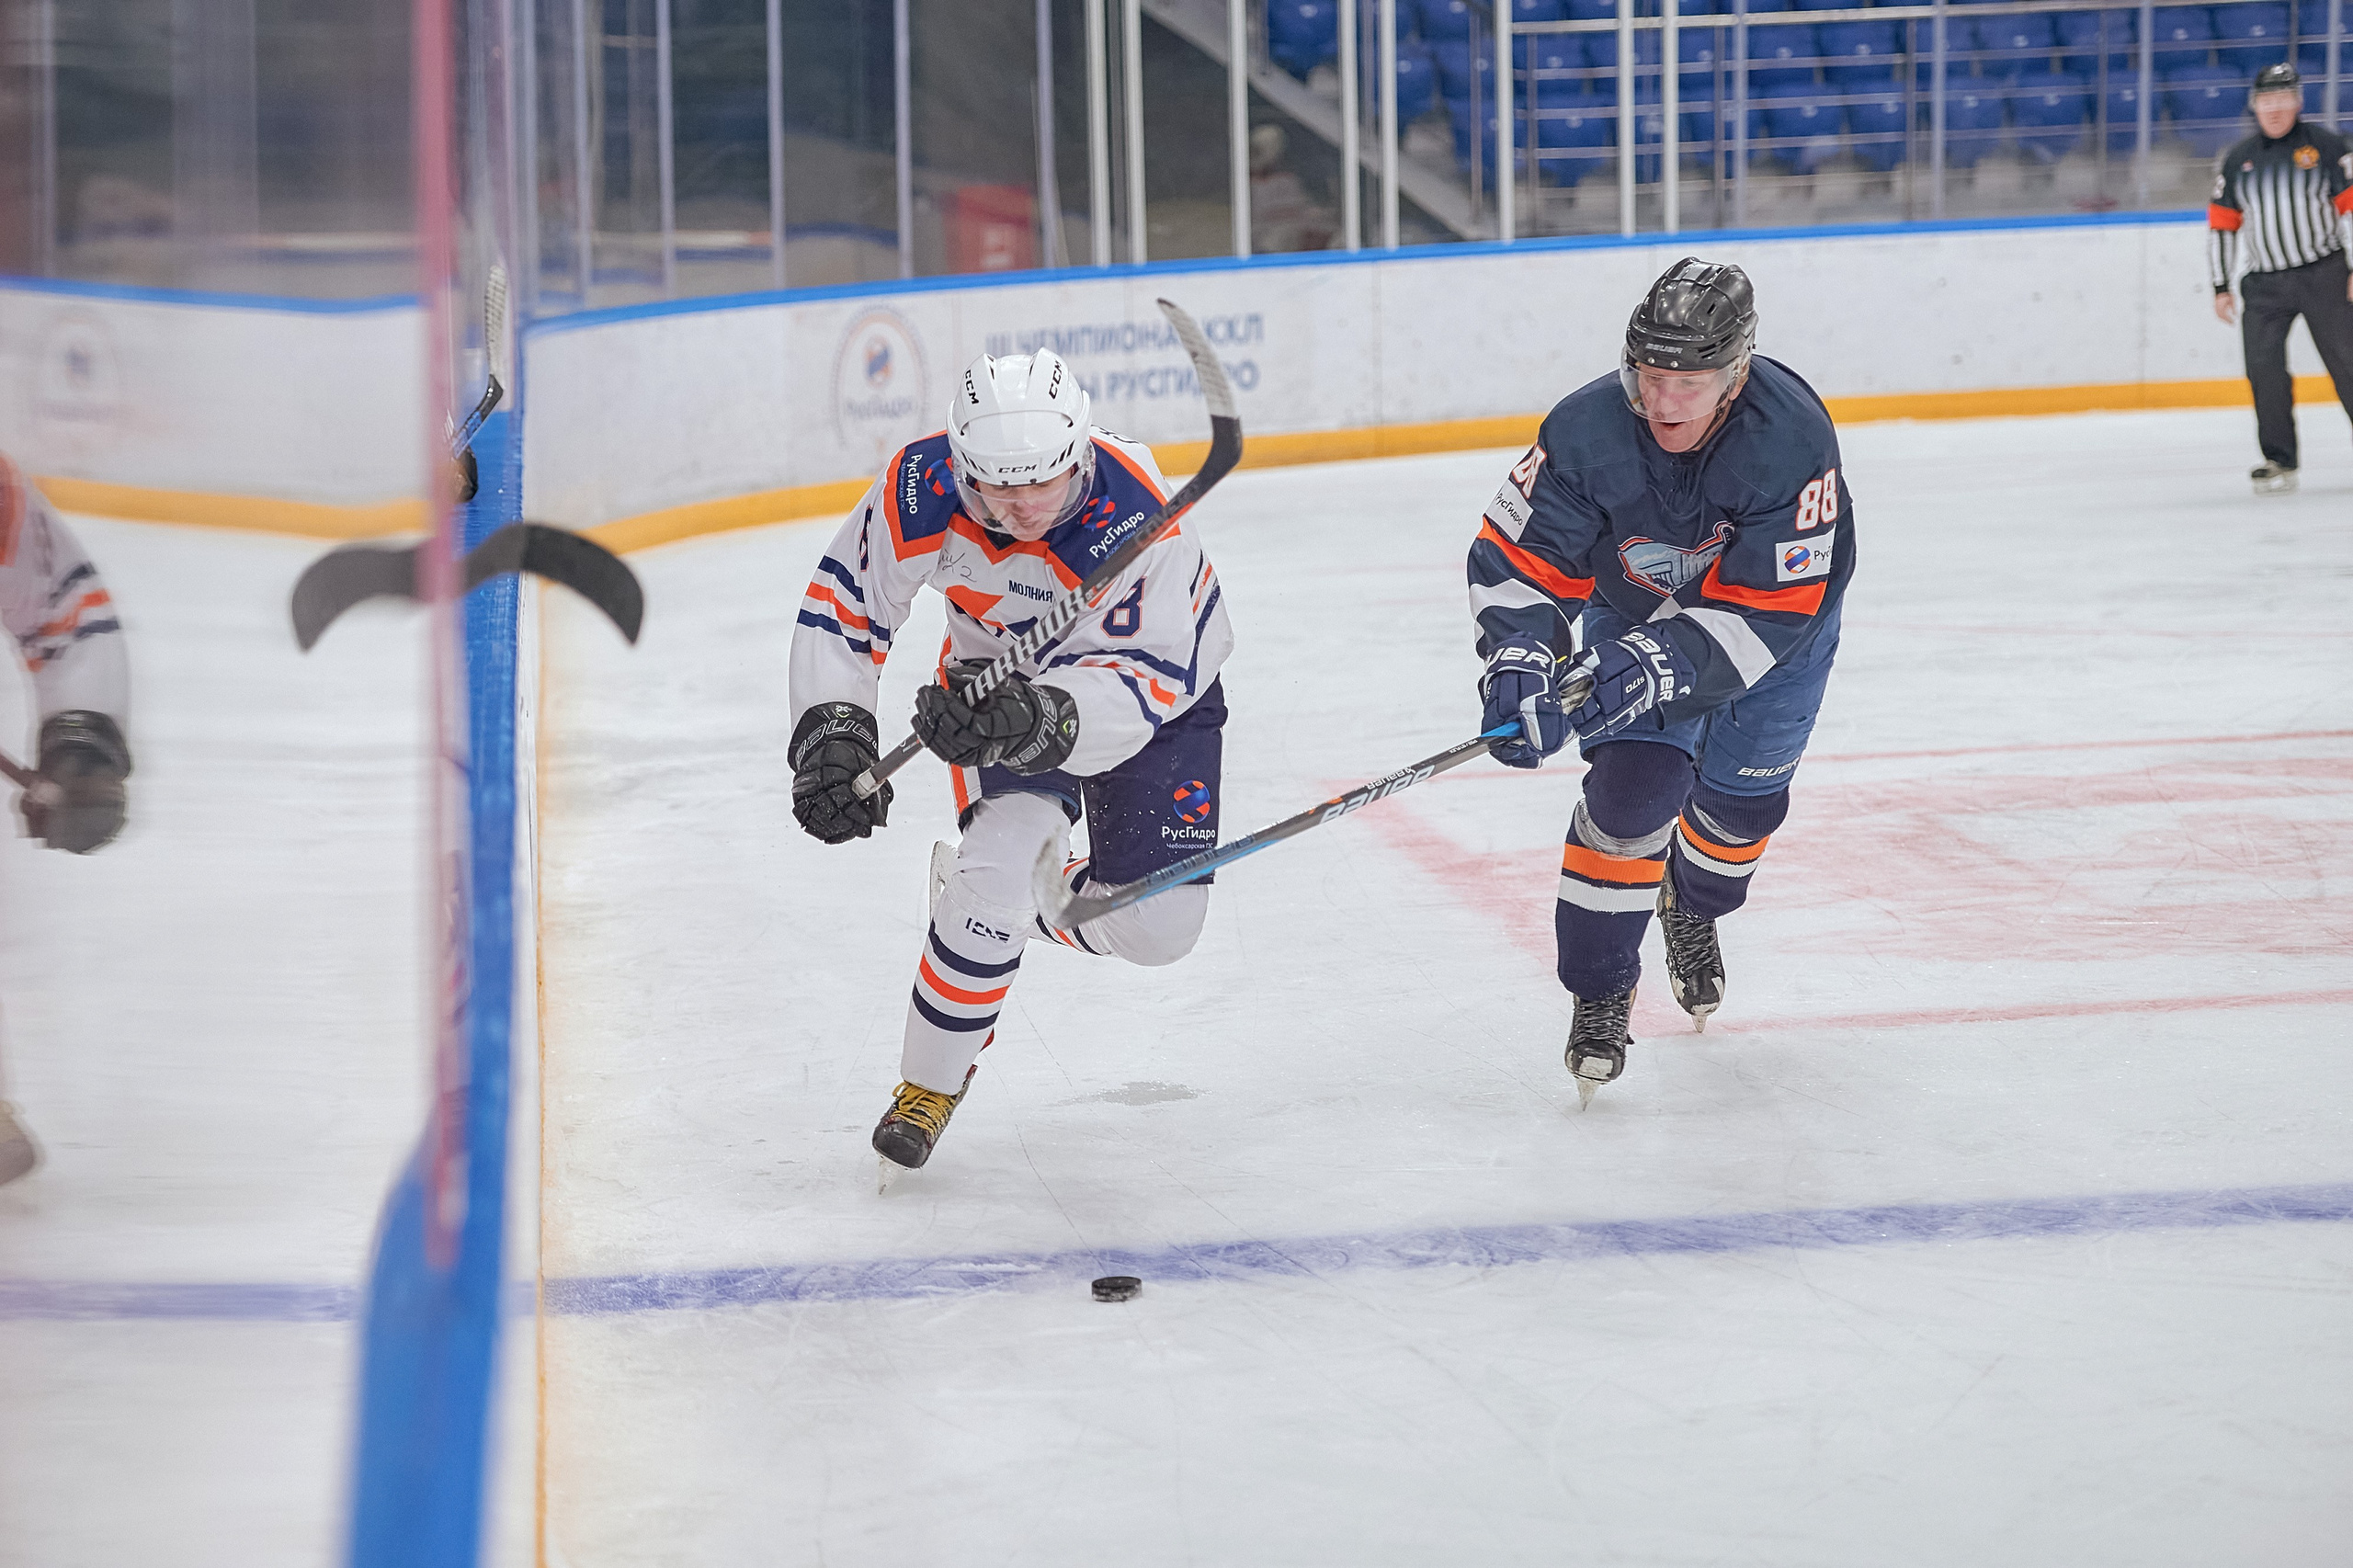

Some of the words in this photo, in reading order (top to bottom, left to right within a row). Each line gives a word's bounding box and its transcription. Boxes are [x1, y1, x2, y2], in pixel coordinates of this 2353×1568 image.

[1017, 319, 1182, 357] ЧЕМПИОНА
[965, 369, 980, 404] CCM
[1048, 358, 1063, 400] CCM
[1107, 359, 1260, 403] РУСГИО
[905, 453, 923, 515] РусГидро
[998, 464, 1038, 473] CCM
[1795, 468, 1838, 531] 88
[1088, 511, 1145, 558] РусГидро
[1008, 579, 1053, 603] МОЛНИЯ
[964, 585, 1086, 708] ARRIOR
[1487, 646, 1551, 670] UER
[1620, 631, 1676, 702] BAUER
[1736, 756, 1801, 777] BAUER
[1162, 826, 1216, 841] РусГидро
